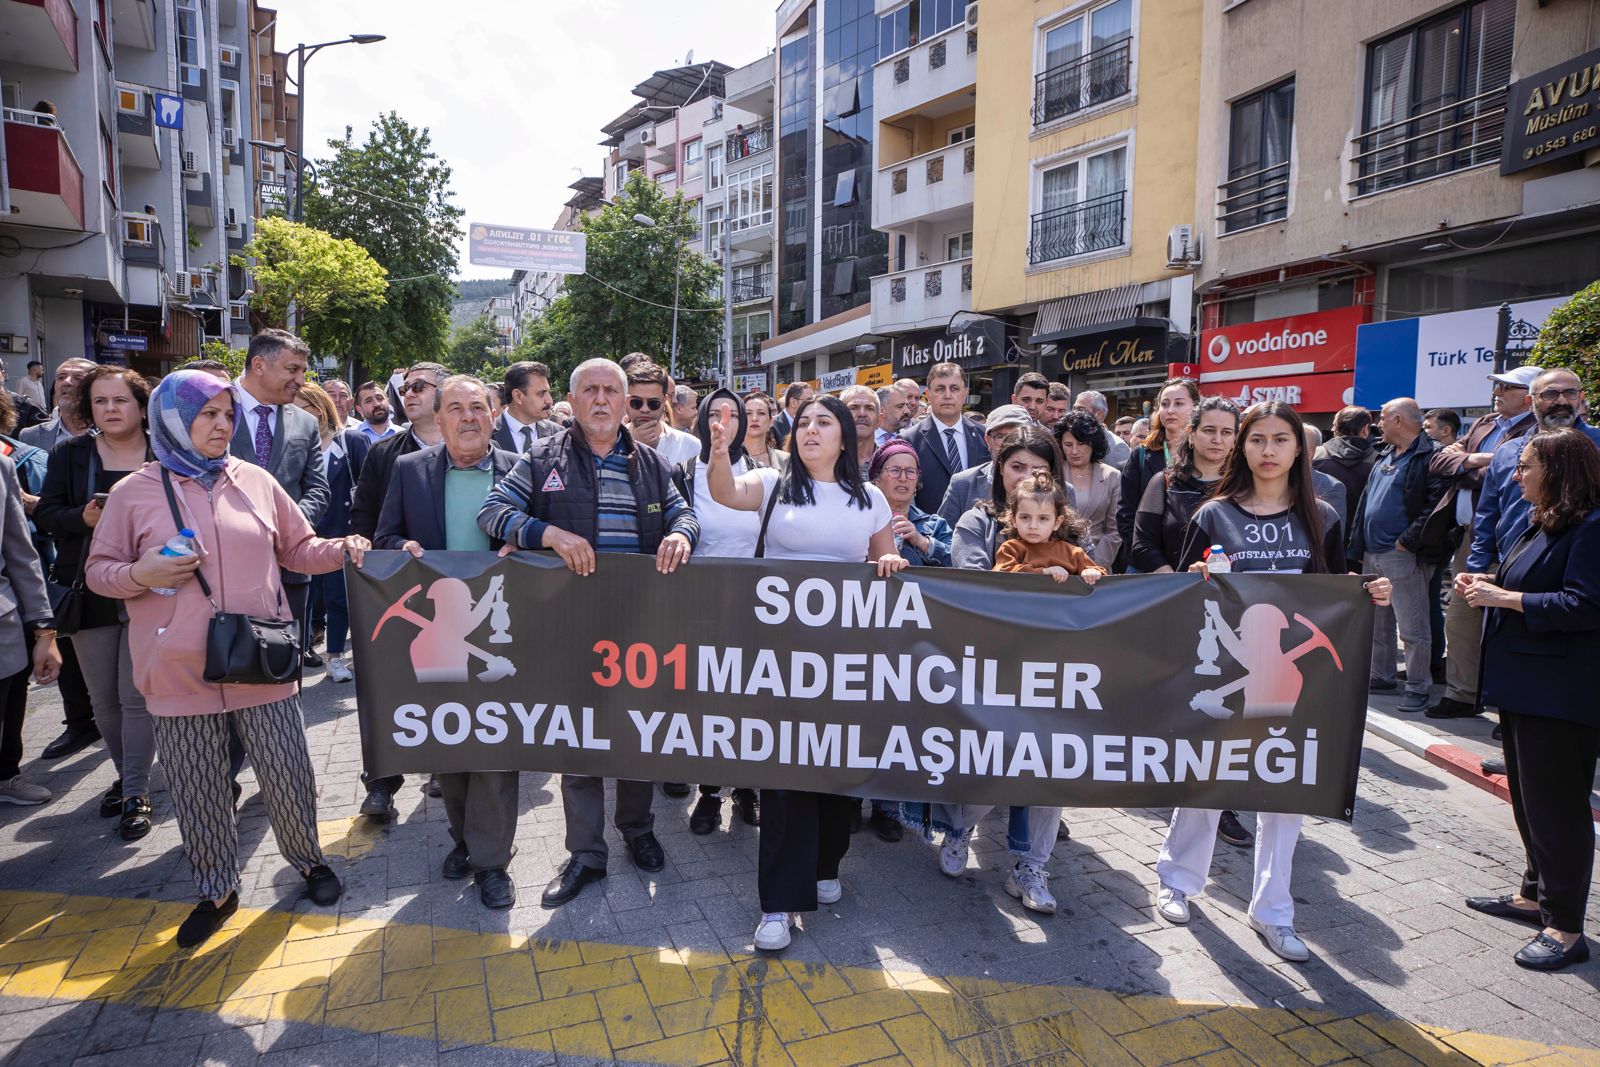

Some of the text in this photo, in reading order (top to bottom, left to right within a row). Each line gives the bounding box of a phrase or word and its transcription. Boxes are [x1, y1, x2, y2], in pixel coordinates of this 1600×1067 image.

[1525, 102, 1589, 136] Müslüm
[1535, 126, 1597, 156] 0543 680
[261, 185, 287, 194] AVUKA
[902, 333, 984, 367] Klas Optik 2
[1109, 338, 1155, 366] Men
[1235, 329, 1328, 355] vodafone
[1428, 347, 1495, 367] Türk Te
[1244, 521, 1294, 544] 301
[1228, 550, 1285, 563] MUSTAFA
[754, 575, 932, 629] SOMA
[392, 701, 611, 751] SOSYAL
